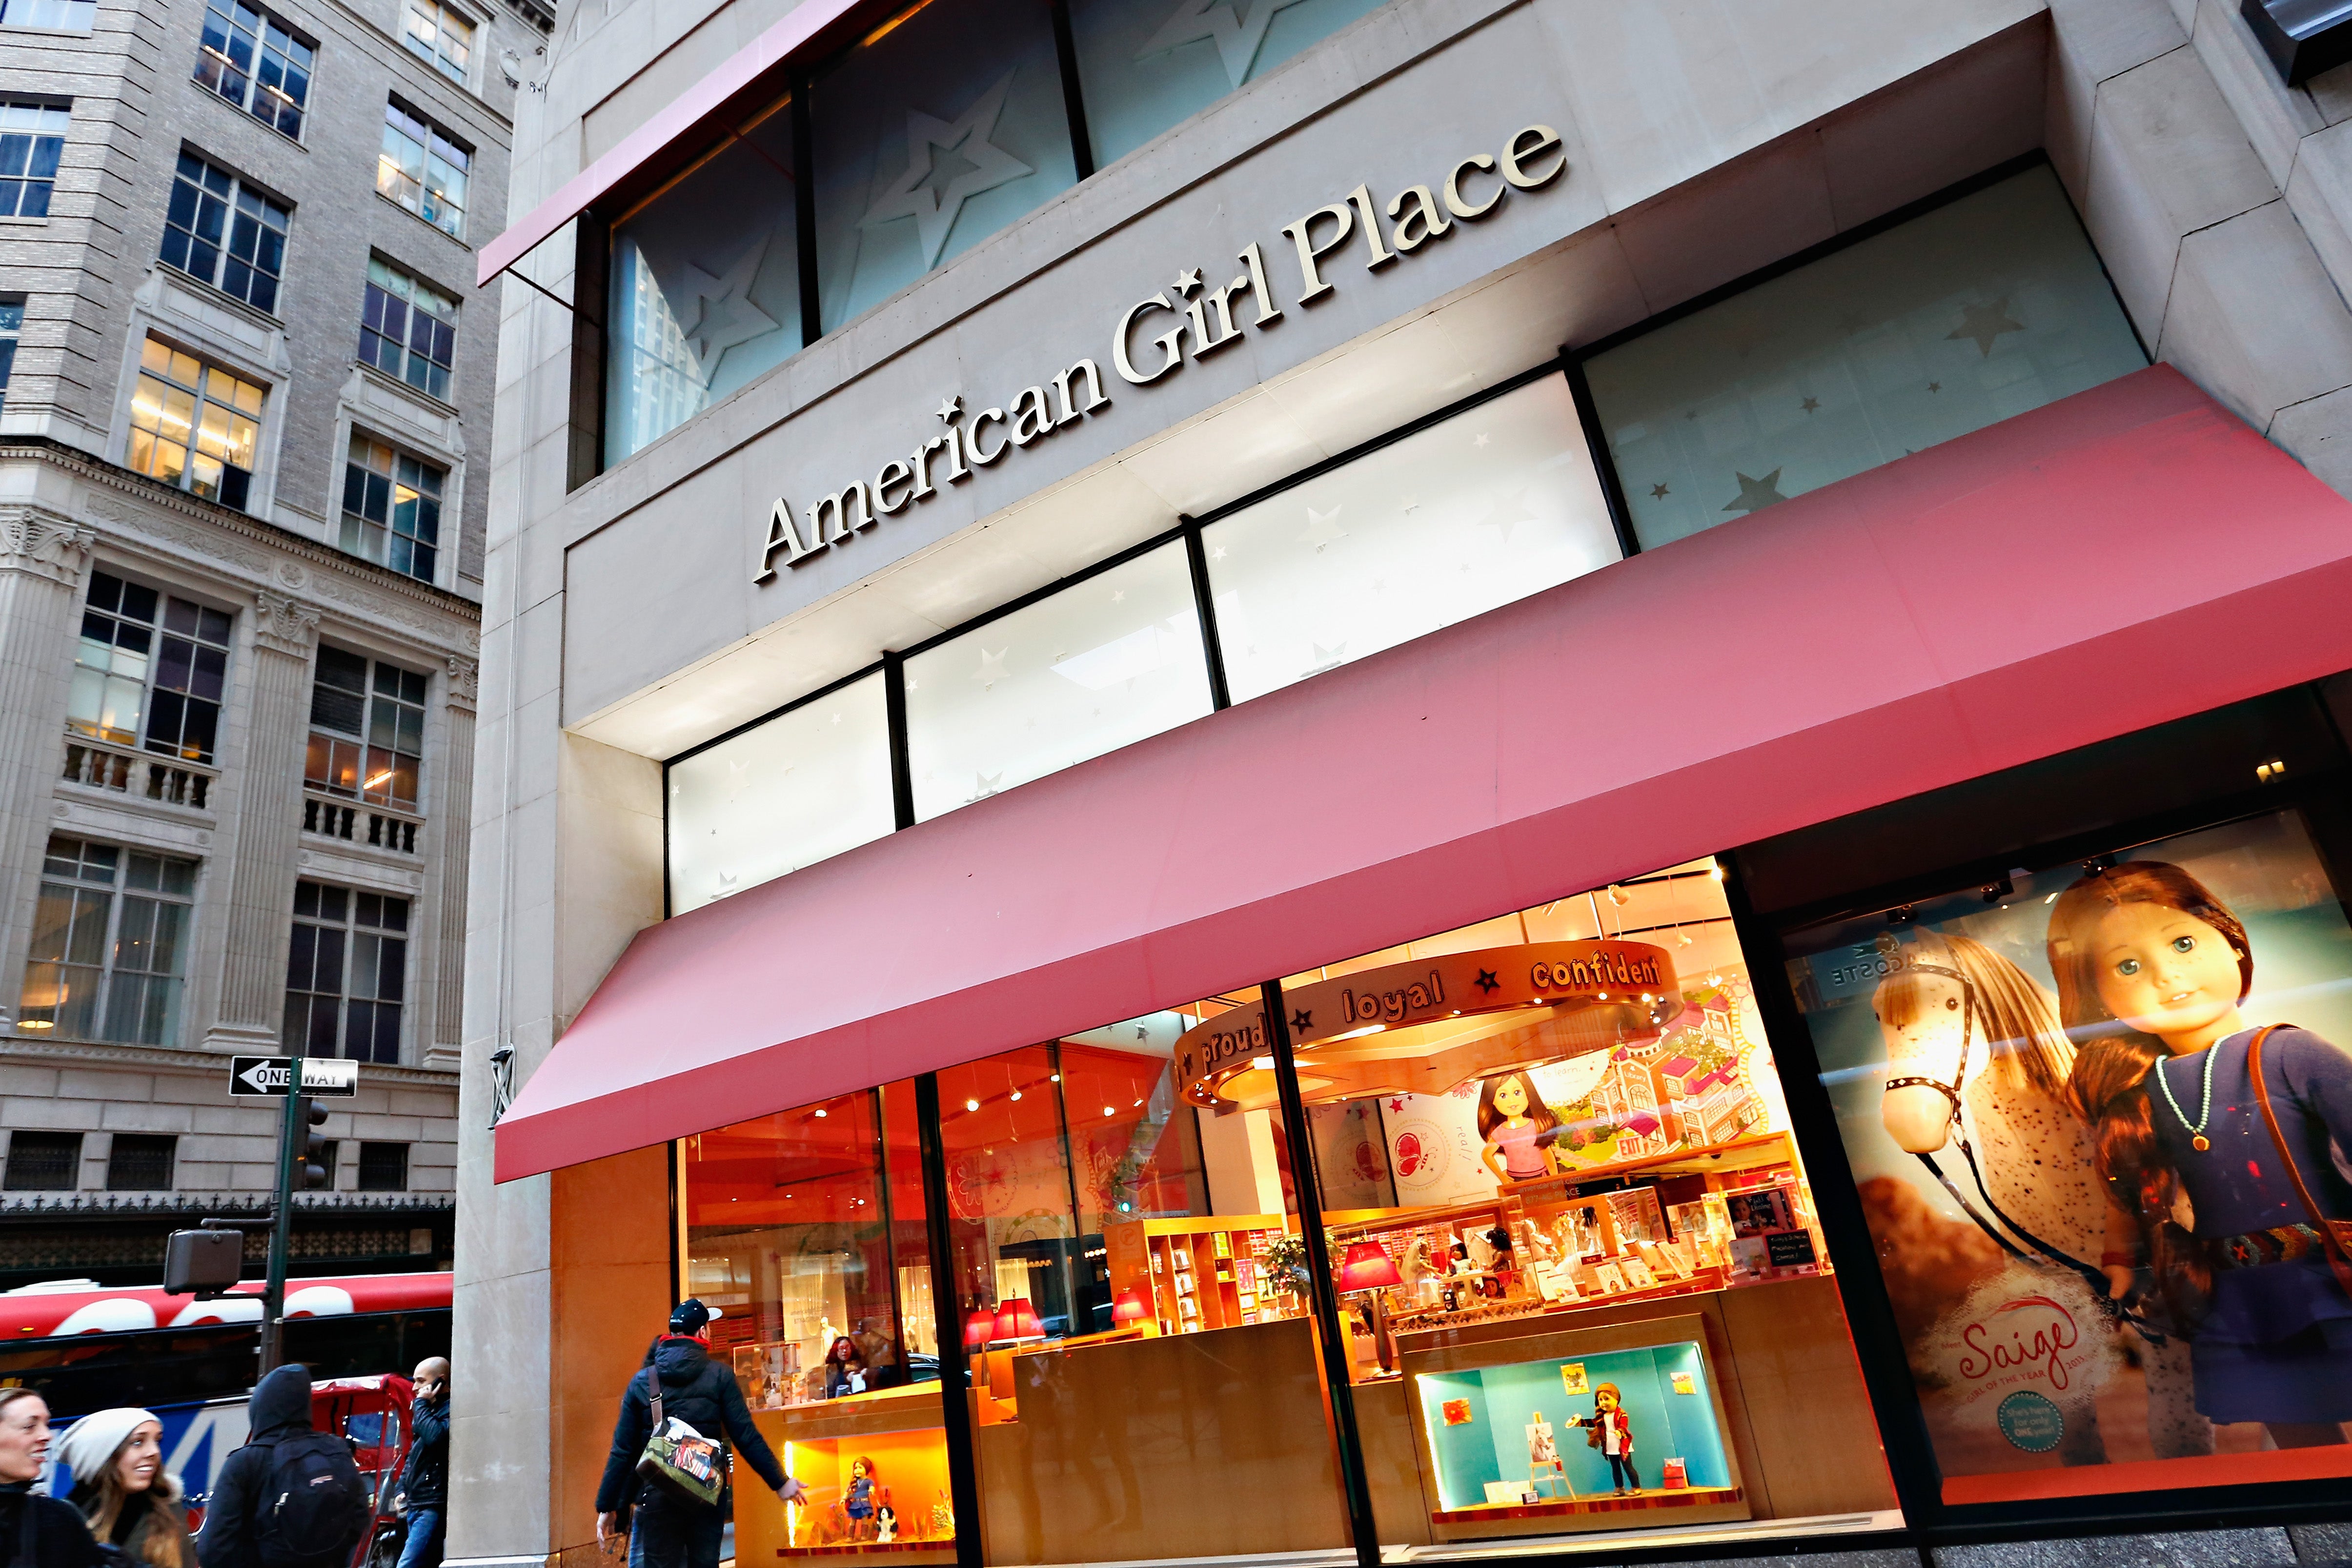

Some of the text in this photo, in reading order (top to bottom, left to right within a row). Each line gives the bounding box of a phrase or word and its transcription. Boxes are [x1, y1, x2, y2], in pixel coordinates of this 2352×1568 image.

[752, 123, 1568, 585] American Girl Place
[1202, 950, 1662, 1074] proud loyal confident
[257, 1069, 336, 1084] ONE WAY
[1624, 1071, 1646, 1082] Library
[1620, 1138, 1641, 1156] EXIT
[1960, 1296, 2078, 1390] Saige
[1967, 1387, 1984, 1403] GIRL
[1986, 1380, 1998, 1390] OF
[2000, 1374, 2019, 1386] THE
[2020, 1369, 2047, 1381] YEAR
